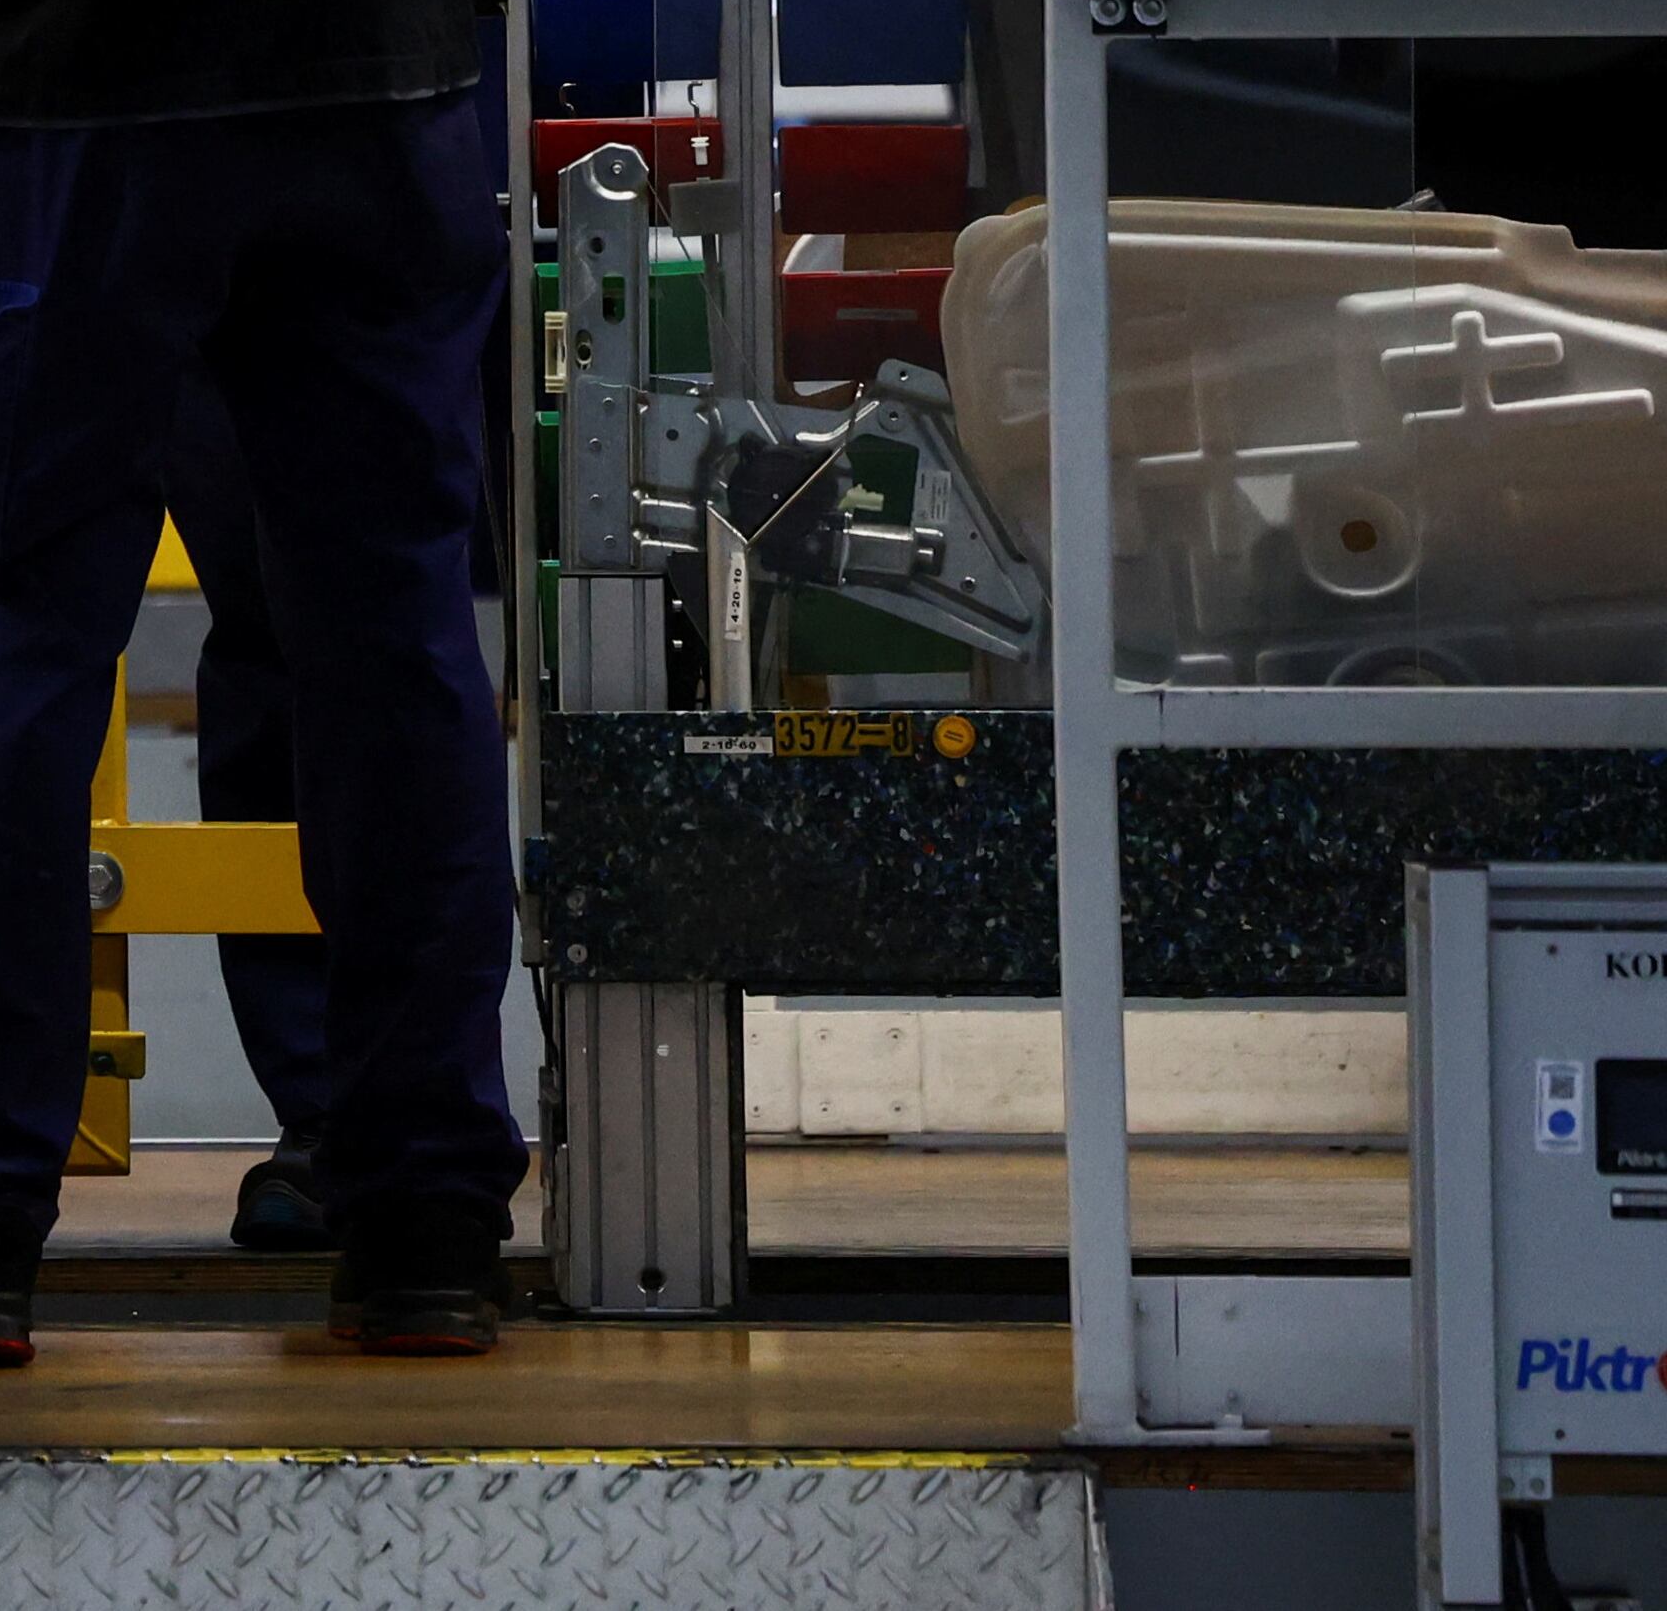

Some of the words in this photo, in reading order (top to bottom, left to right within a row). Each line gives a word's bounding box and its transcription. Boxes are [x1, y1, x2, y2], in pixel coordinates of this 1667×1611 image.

[730, 568, 742, 623] 4-20-10
[1605, 952, 1667, 979] KO
[1517, 1338, 1667, 1392] Piktr
